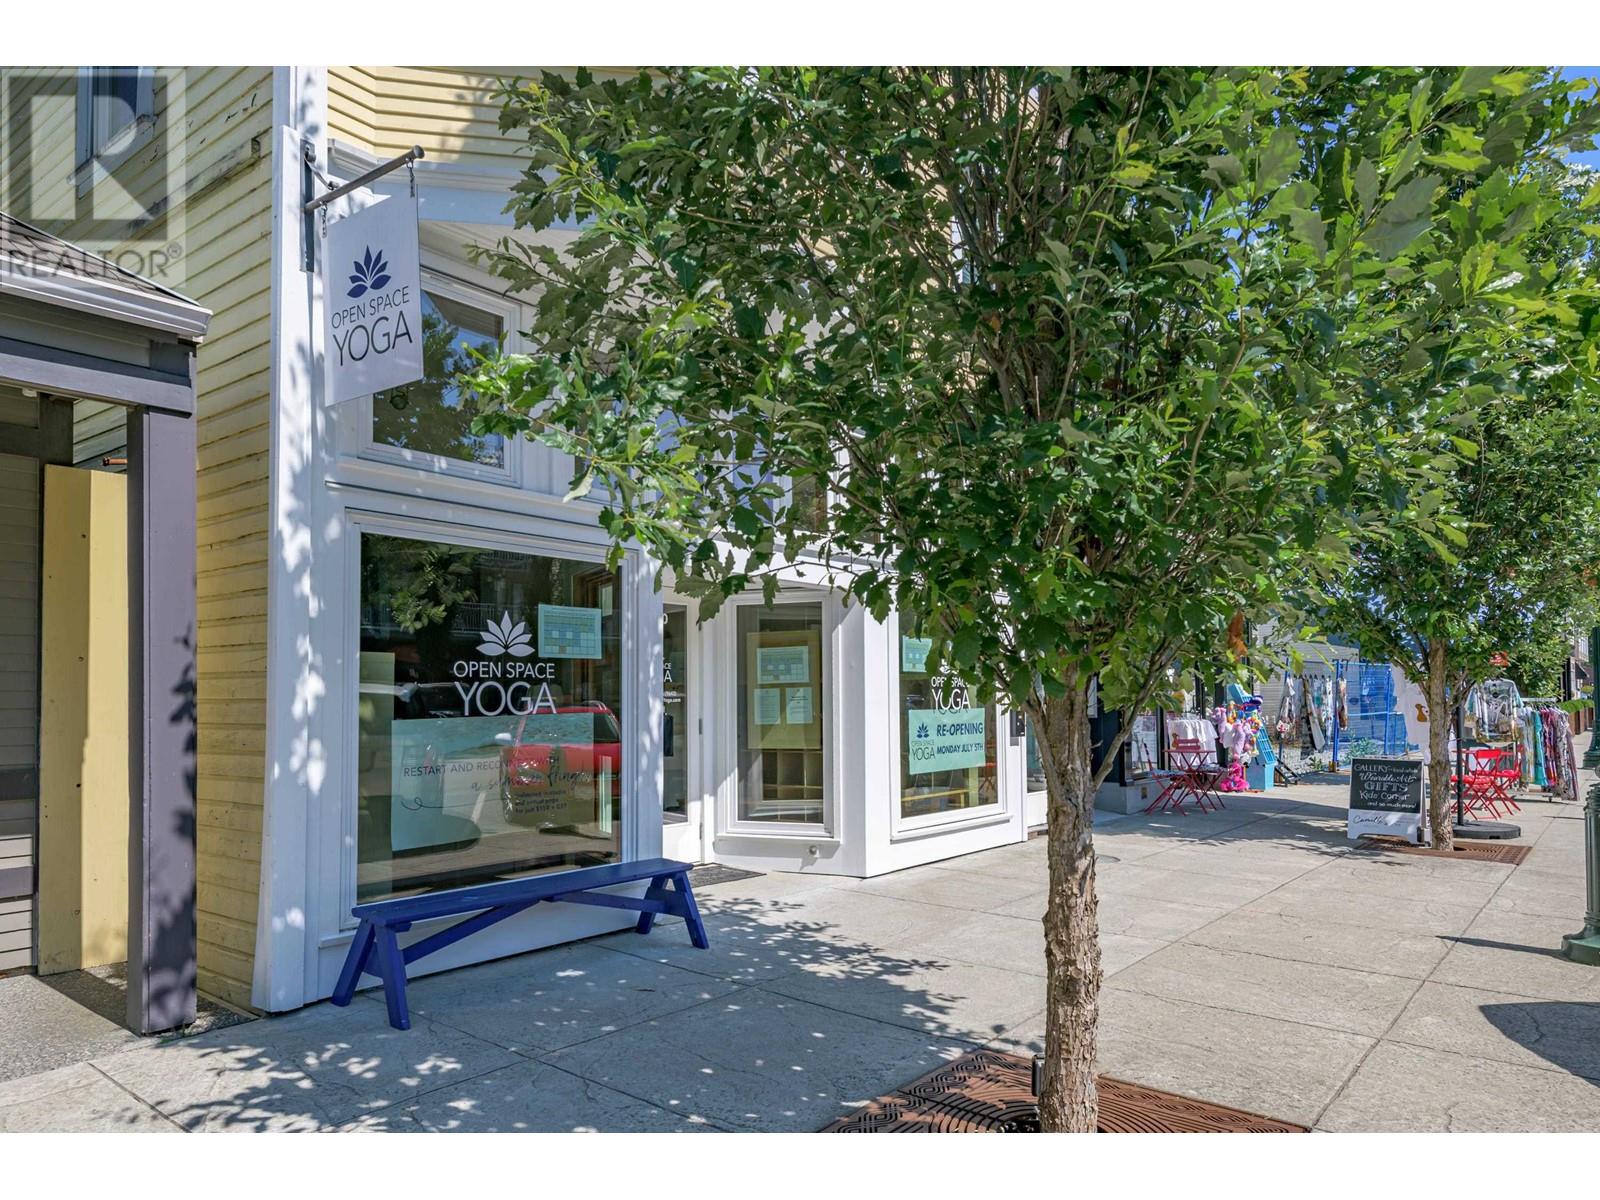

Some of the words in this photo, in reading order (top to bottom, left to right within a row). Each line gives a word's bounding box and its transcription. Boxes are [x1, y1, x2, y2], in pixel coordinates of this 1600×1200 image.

[331, 303, 366, 329] OPEN
[369, 285, 410, 316] SPACE
[332, 310, 413, 367] YOGA
[453, 660, 502, 679] OPEN
[506, 662, 556, 679] SPACE
[931, 676, 947, 687] OPE
[453, 681, 557, 716] YOGA
[936, 722, 984, 737] RE-OPENING
[911, 746, 936, 761] YOGA
[936, 745, 960, 755] MONDAY
[961, 743, 974, 753] JULY
[974, 742, 984, 752] 5TH
[403, 764, 447, 777] RESTART
[450, 761, 473, 773] AND
[1354, 764, 1390, 772] GALLERY
[1364, 781, 1408, 791] GIFTS
